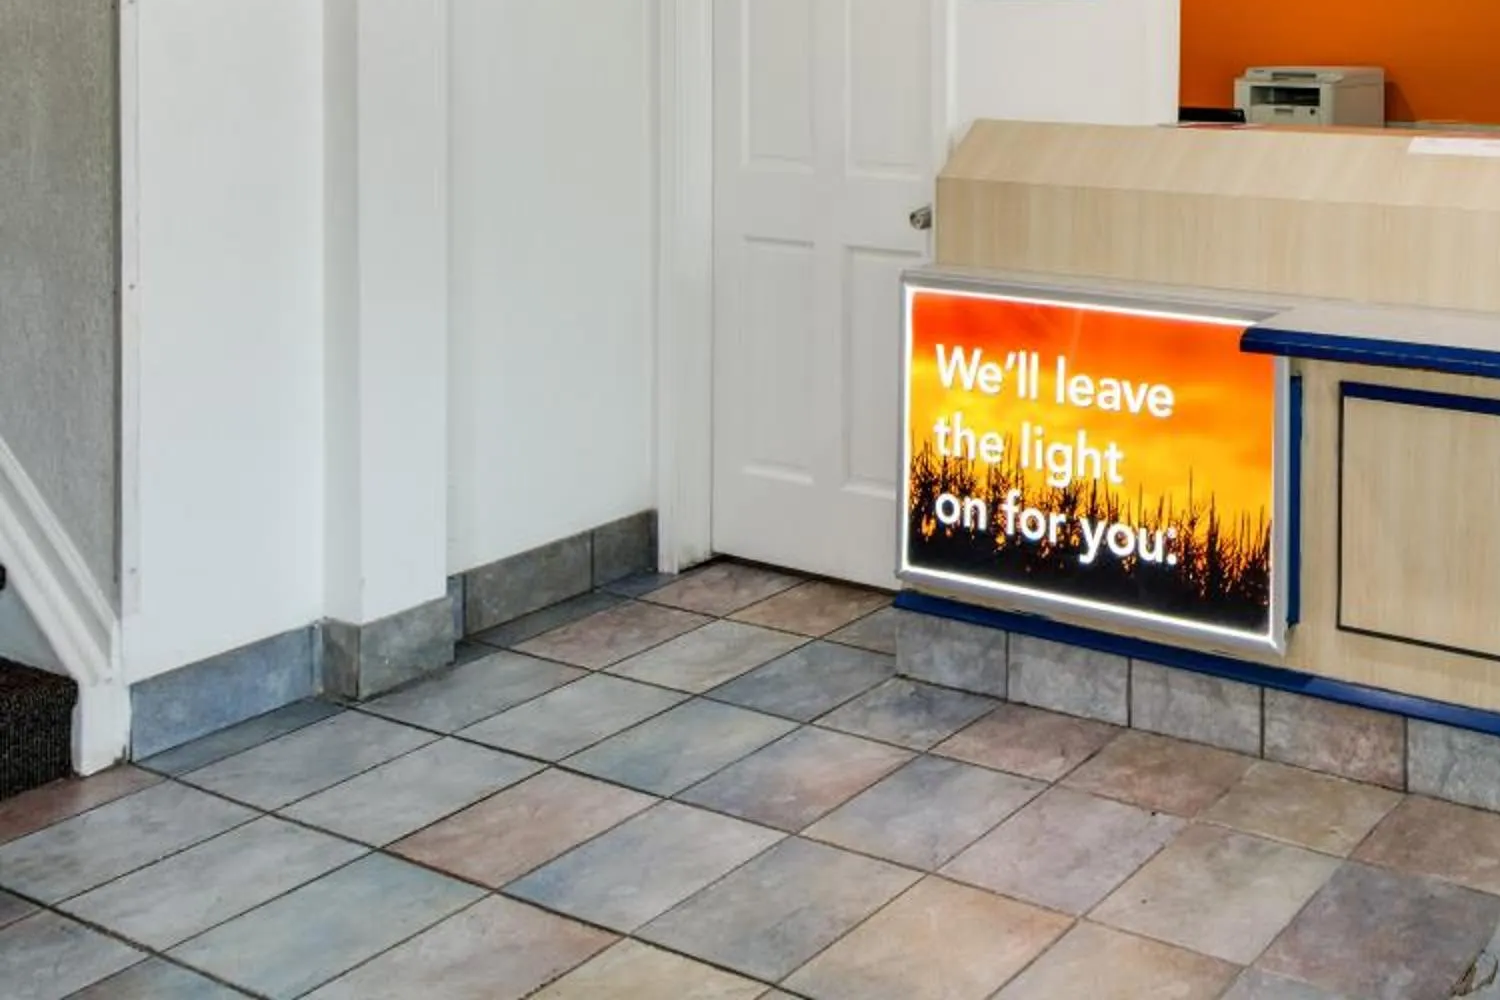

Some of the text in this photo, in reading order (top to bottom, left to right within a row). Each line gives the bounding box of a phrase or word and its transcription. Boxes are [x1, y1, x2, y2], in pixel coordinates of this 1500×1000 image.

[935, 343, 1175, 418] We'll leave
[933, 411, 1124, 489] the light
[935, 492, 988, 531] on
[1003, 489, 1067, 543] for
